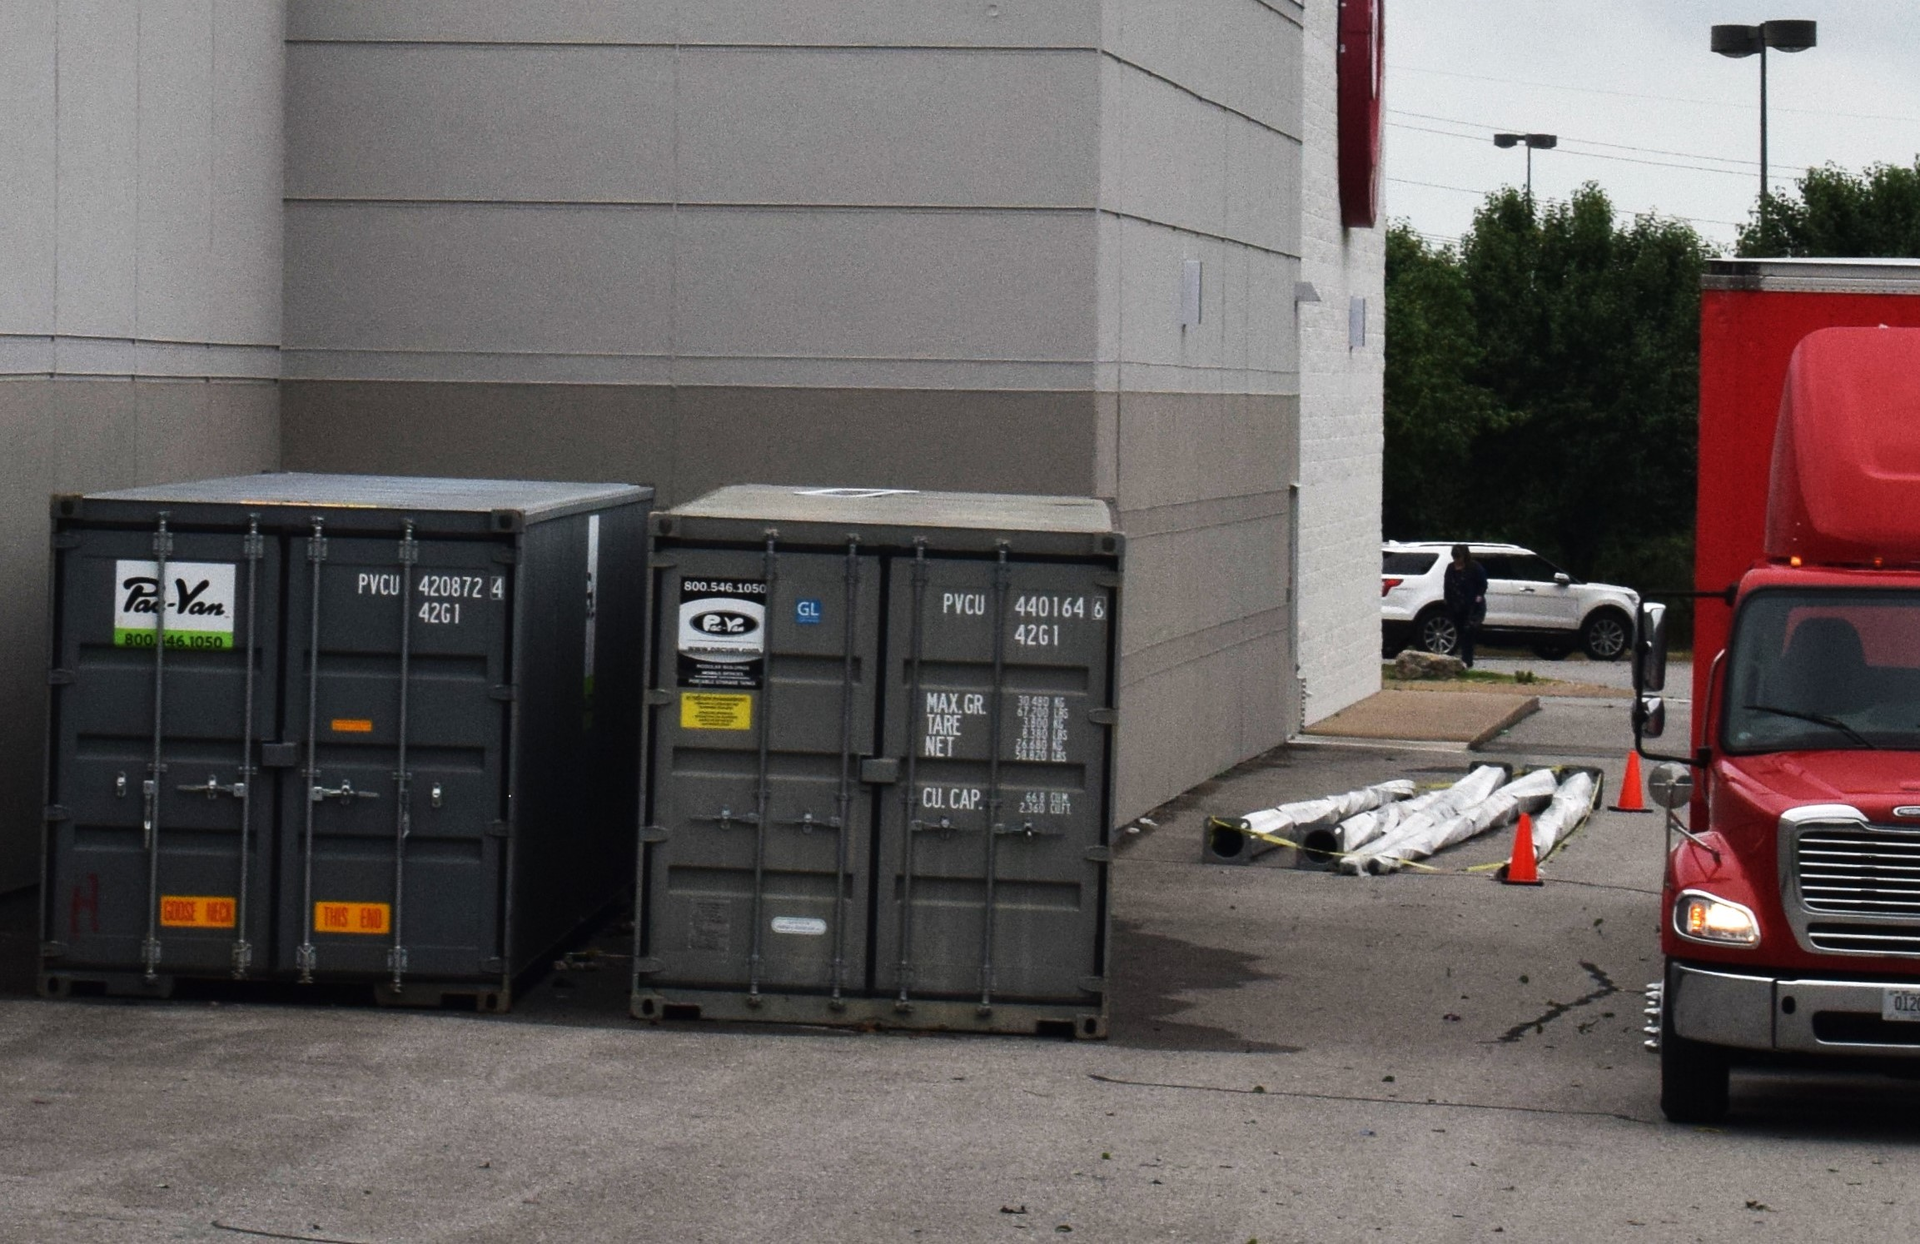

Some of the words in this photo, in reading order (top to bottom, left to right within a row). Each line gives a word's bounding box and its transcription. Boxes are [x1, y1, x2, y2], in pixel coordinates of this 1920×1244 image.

[358, 573, 400, 595] PVCU
[418, 575, 483, 598] 420872
[491, 577, 504, 599] 4
[684, 581, 767, 594] 800.546.1050
[418, 602, 460, 624] 42G1
[797, 602, 820, 616] GL
[943, 593, 986, 615] PVCU
[1015, 596, 1084, 618] 440164
[1093, 599, 1104, 619] 6
[125, 632, 224, 649] 800.46.1050
[1015, 624, 1059, 646] 42G1
[926, 714, 962, 735] TARE
[925, 736, 955, 757] NET
[923, 787, 945, 809] CU.
[949, 788, 983, 810] CAP.
[164, 900, 196, 922] GOOSE
[206, 901, 232, 923] NECK
[324, 906, 348, 928] THIS
[360, 907, 382, 929] END
